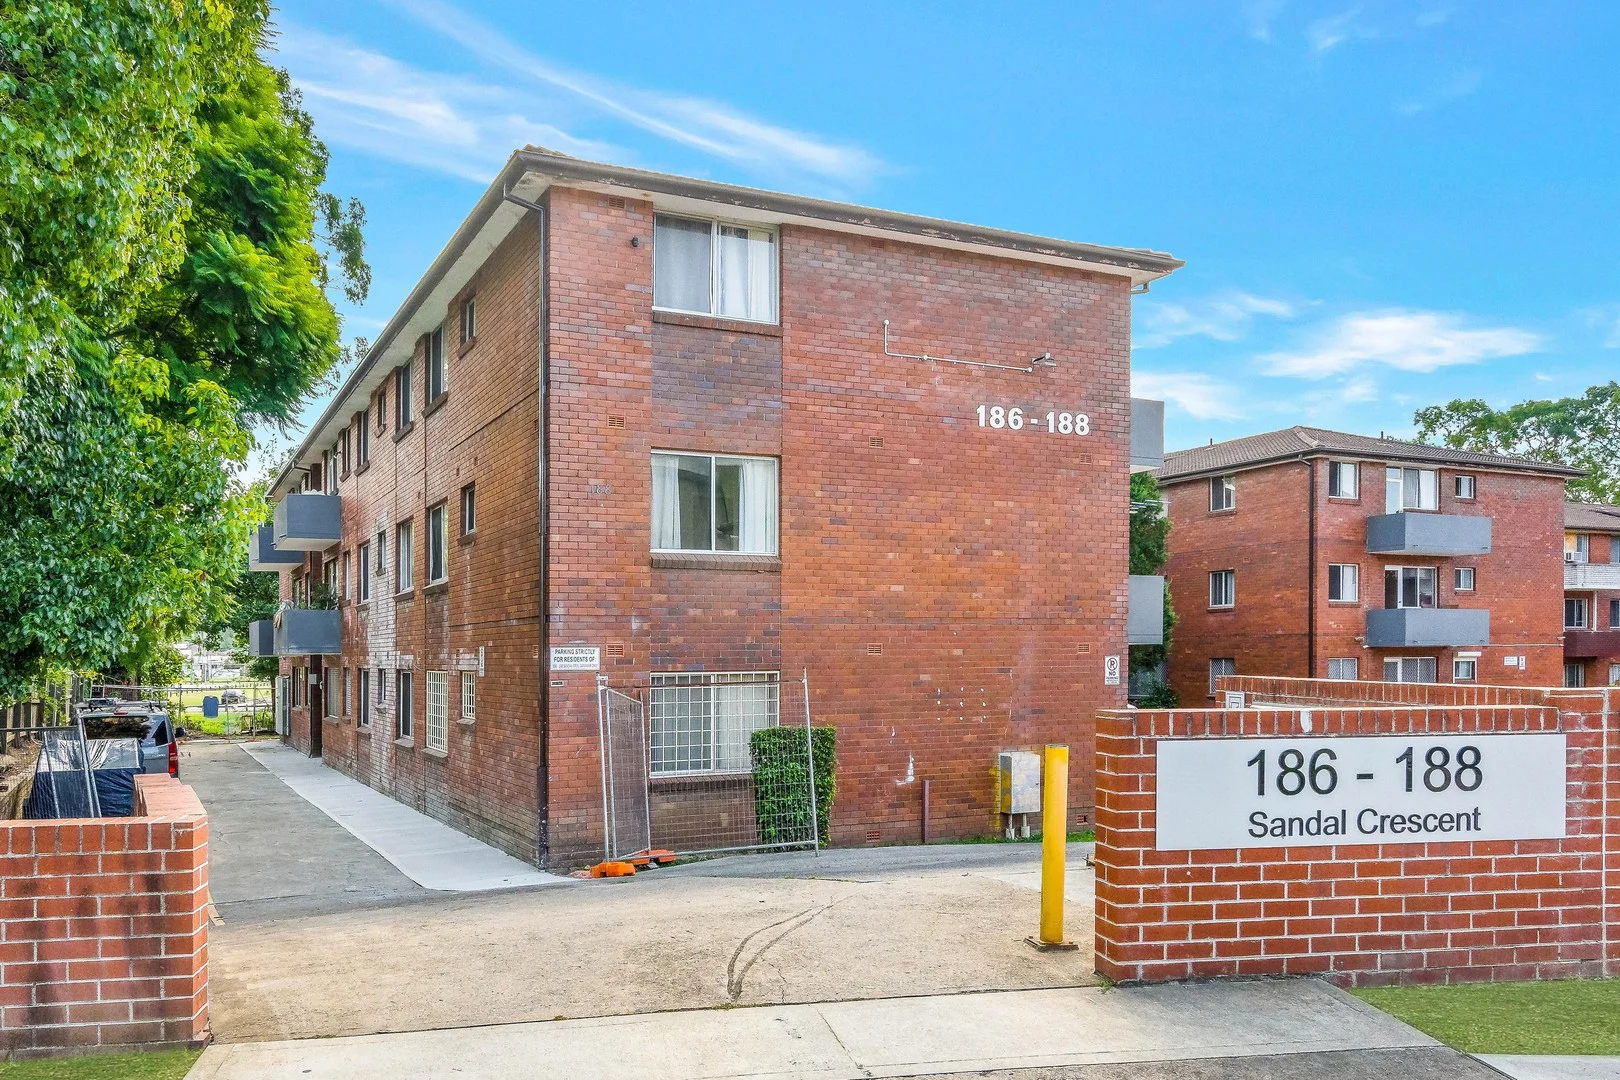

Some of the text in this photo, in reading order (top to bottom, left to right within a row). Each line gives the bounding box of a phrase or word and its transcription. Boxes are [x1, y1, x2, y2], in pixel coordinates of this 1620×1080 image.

[976, 405, 1024, 430] 186
[1046, 411, 1090, 436] 188
[1247, 745, 1483, 796] 186 - 188
[1248, 806, 1482, 838] Sandal Crescent
